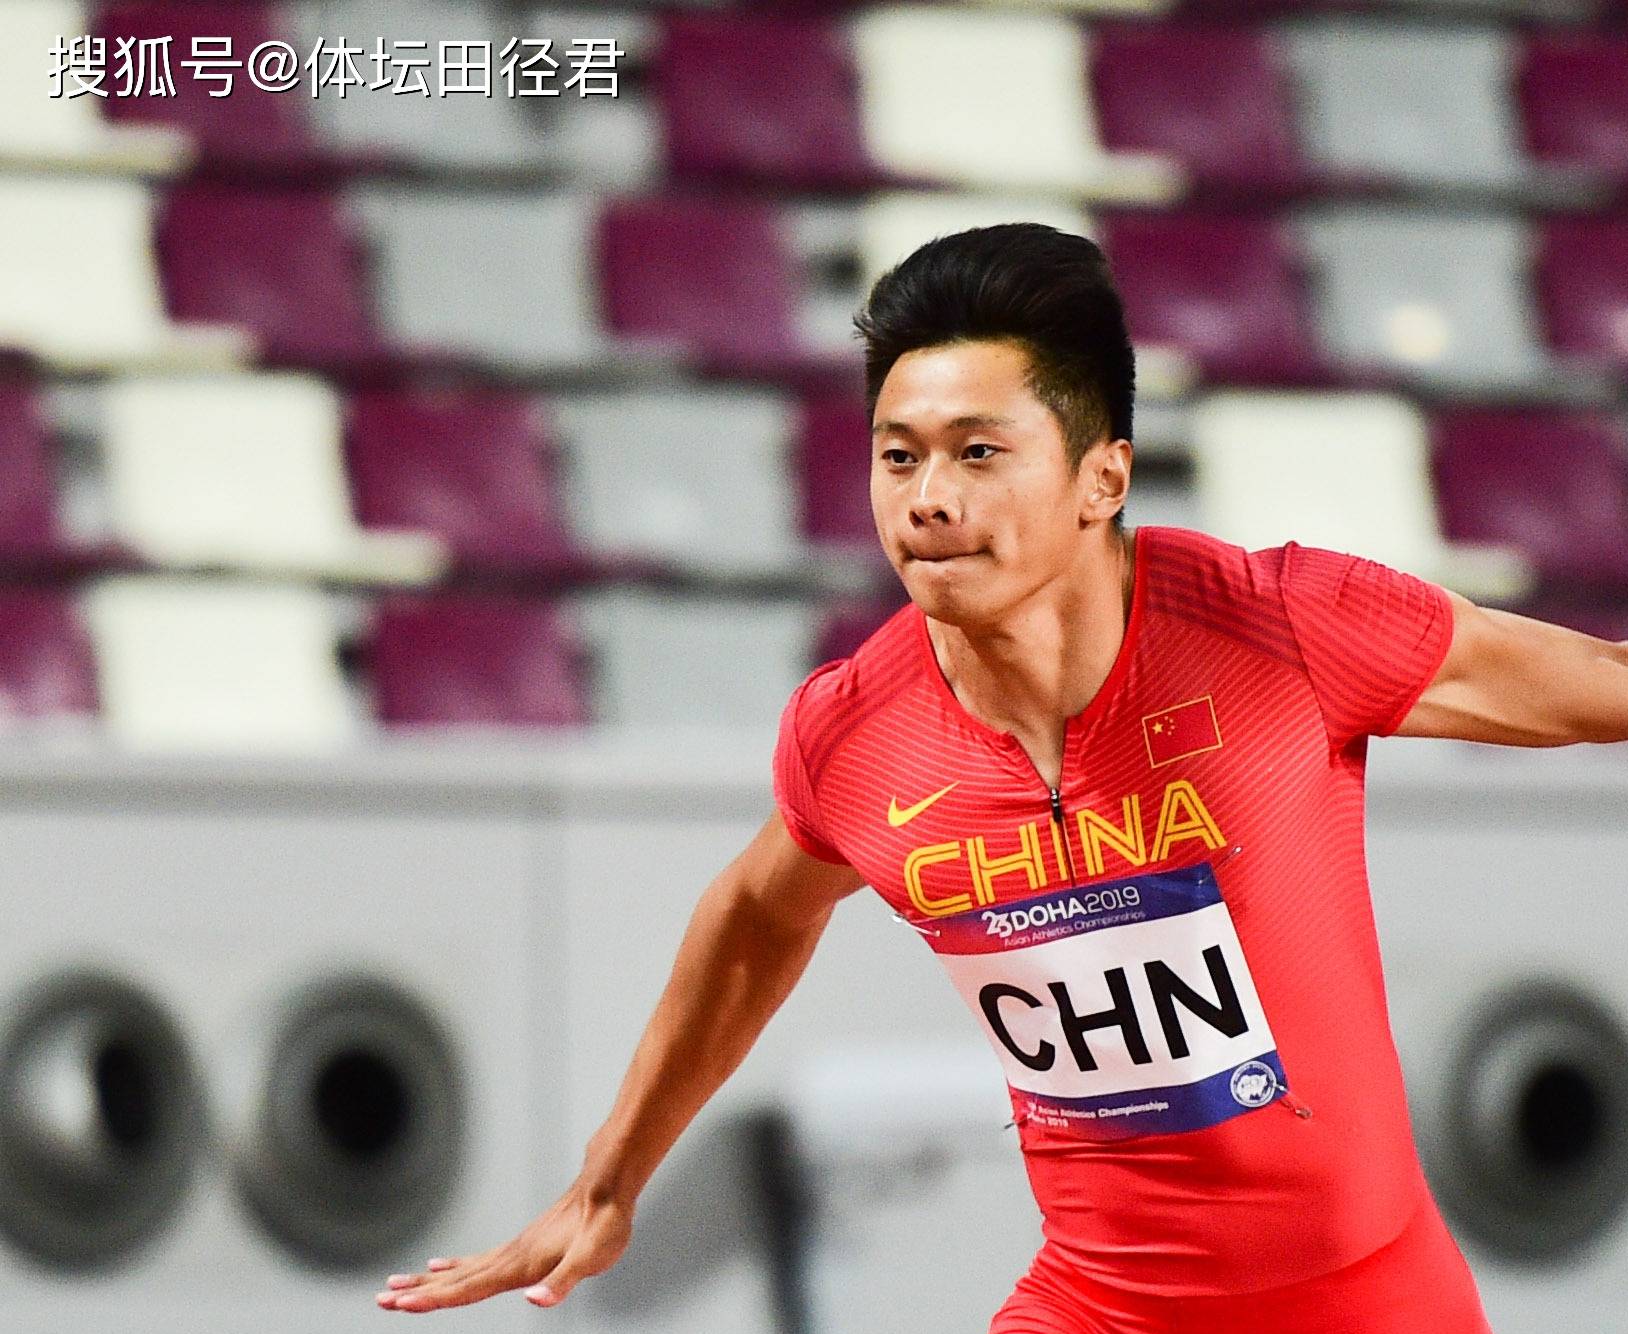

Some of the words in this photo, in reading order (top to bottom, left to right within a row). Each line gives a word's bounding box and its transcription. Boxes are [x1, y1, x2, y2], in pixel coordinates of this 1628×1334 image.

[904, 779, 1227, 917] CHINA
[1073, 910, 1147, 932] Championships
[978, 944, 1249, 1072] CHN
